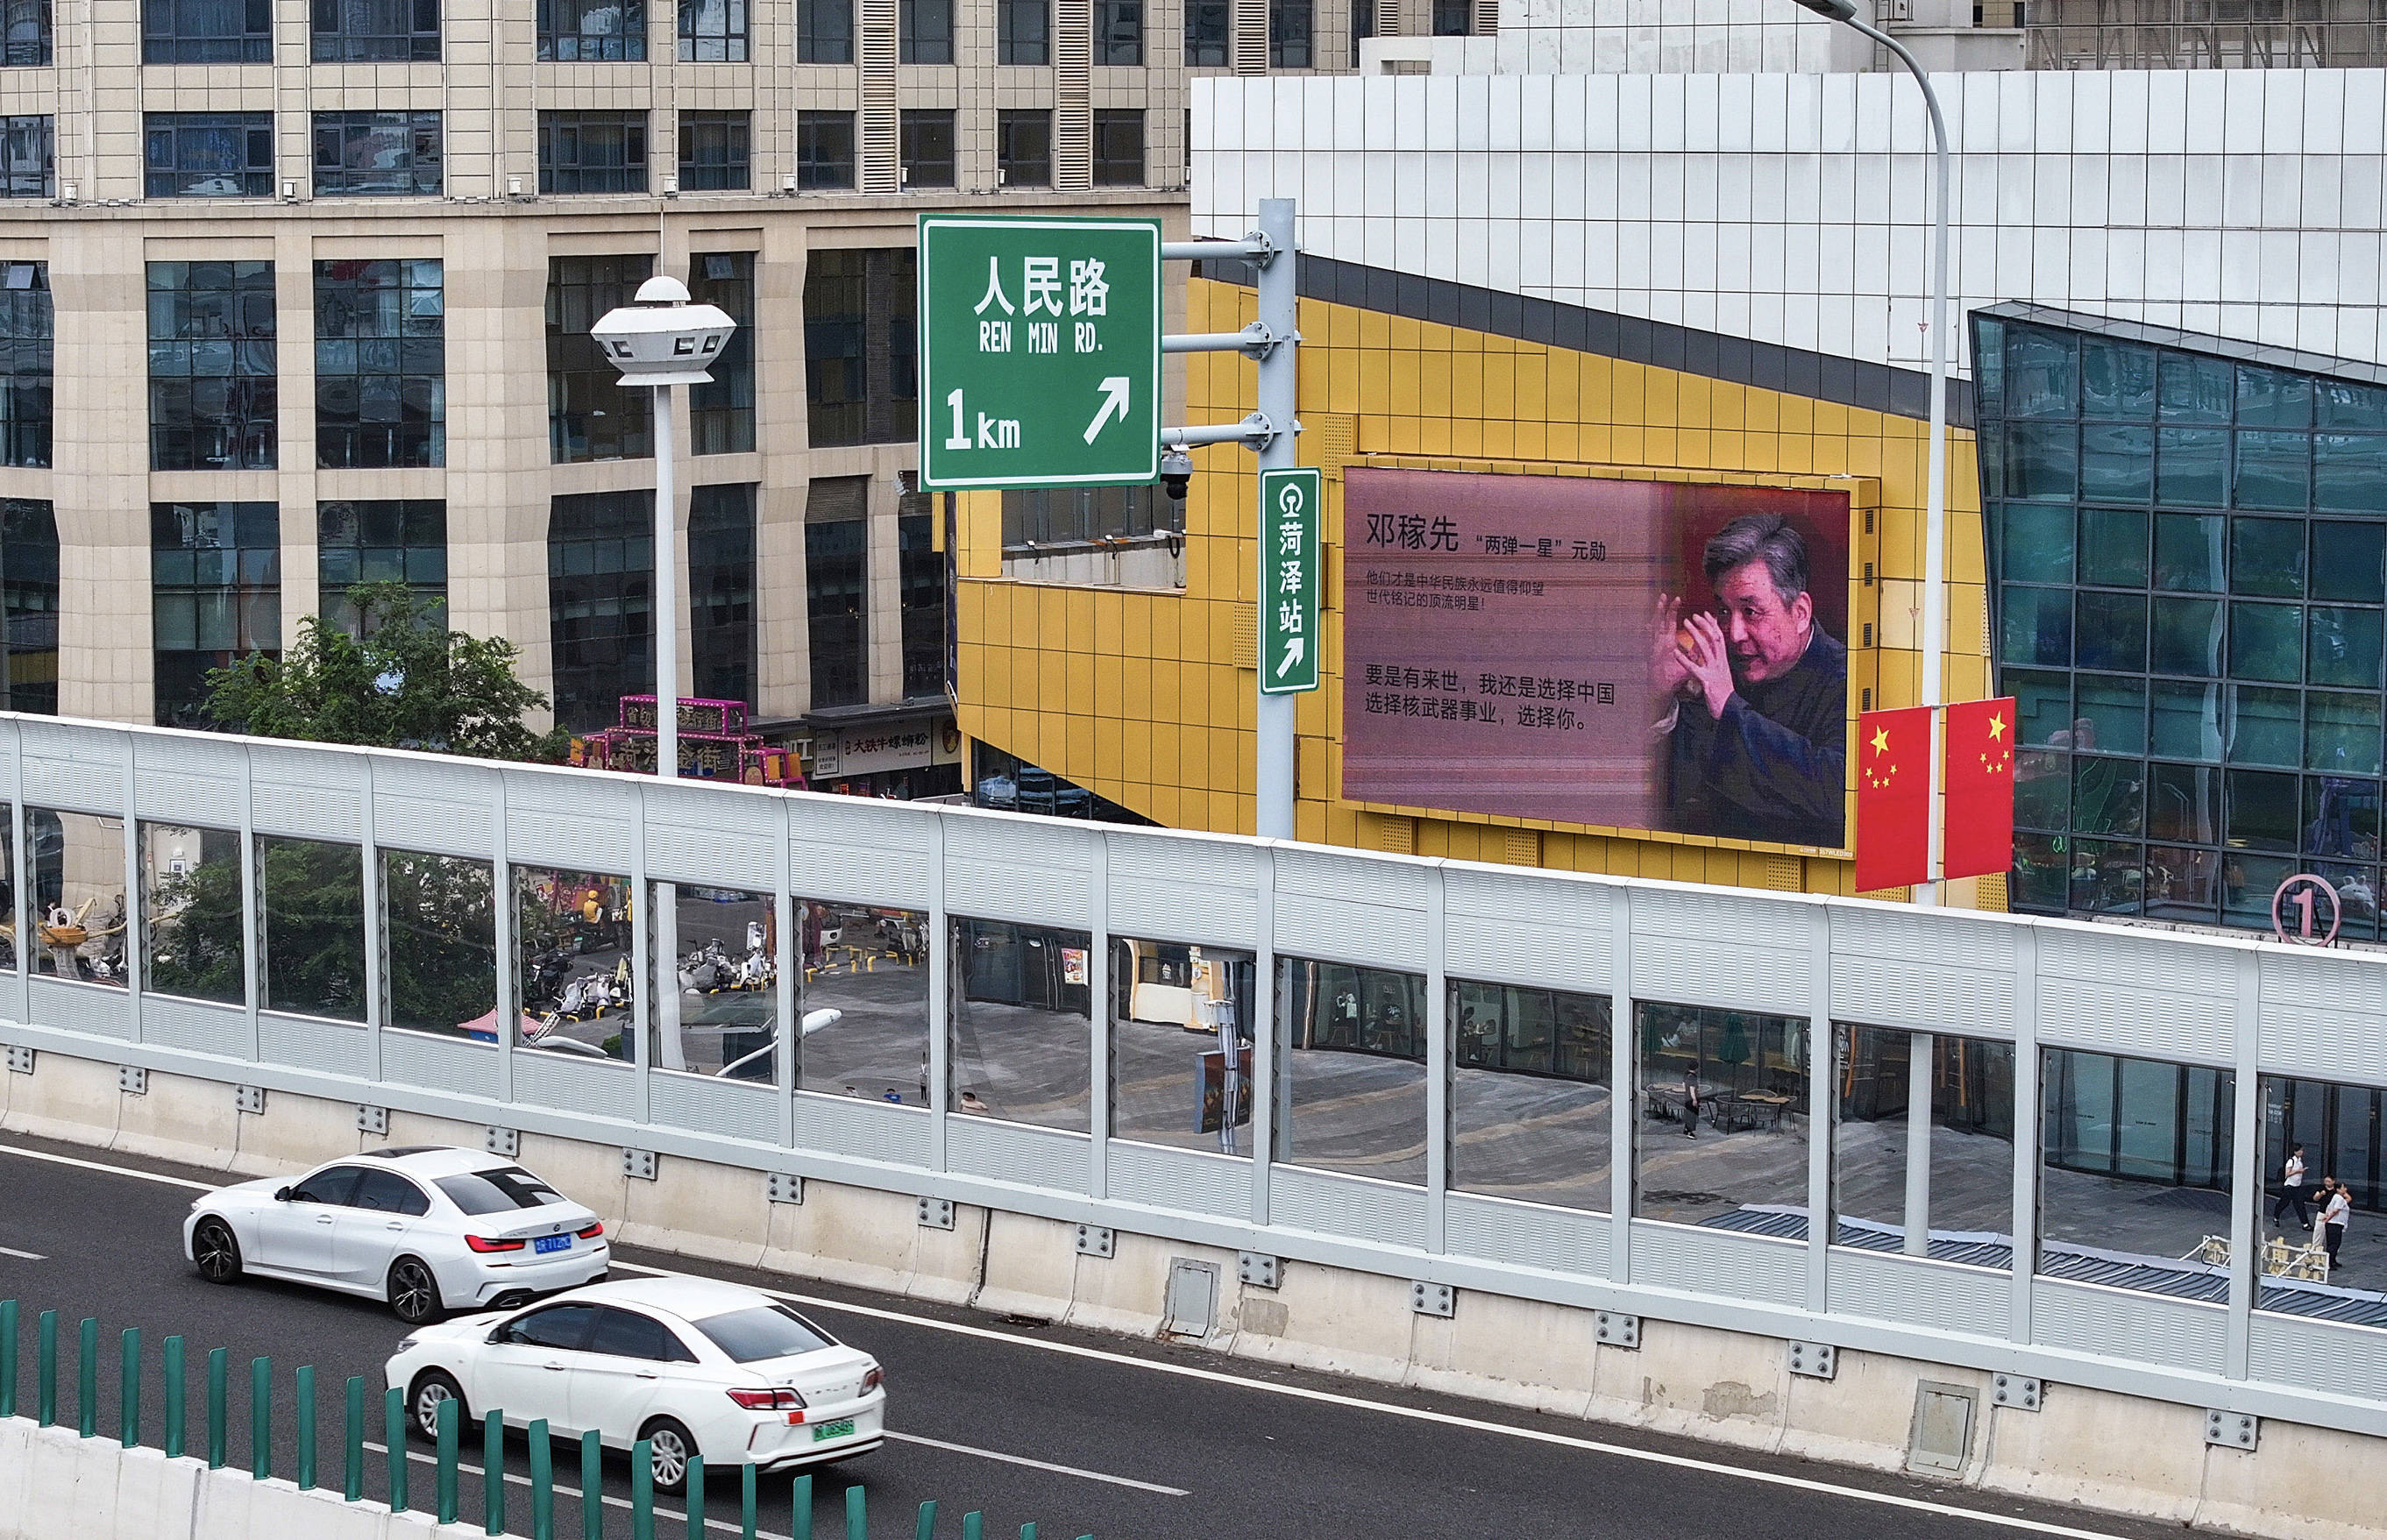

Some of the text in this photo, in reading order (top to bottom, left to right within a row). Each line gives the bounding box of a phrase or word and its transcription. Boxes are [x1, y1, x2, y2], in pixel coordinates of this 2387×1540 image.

[974, 256, 1110, 317] 人民路
[979, 321, 1103, 354] REN MIN RD.
[1366, 514, 1459, 552] 邓稼先
[1279, 522, 1304, 635] 菏泽站
[1366, 570, 1545, 597] 他们才是中华民族永远值得仰望
